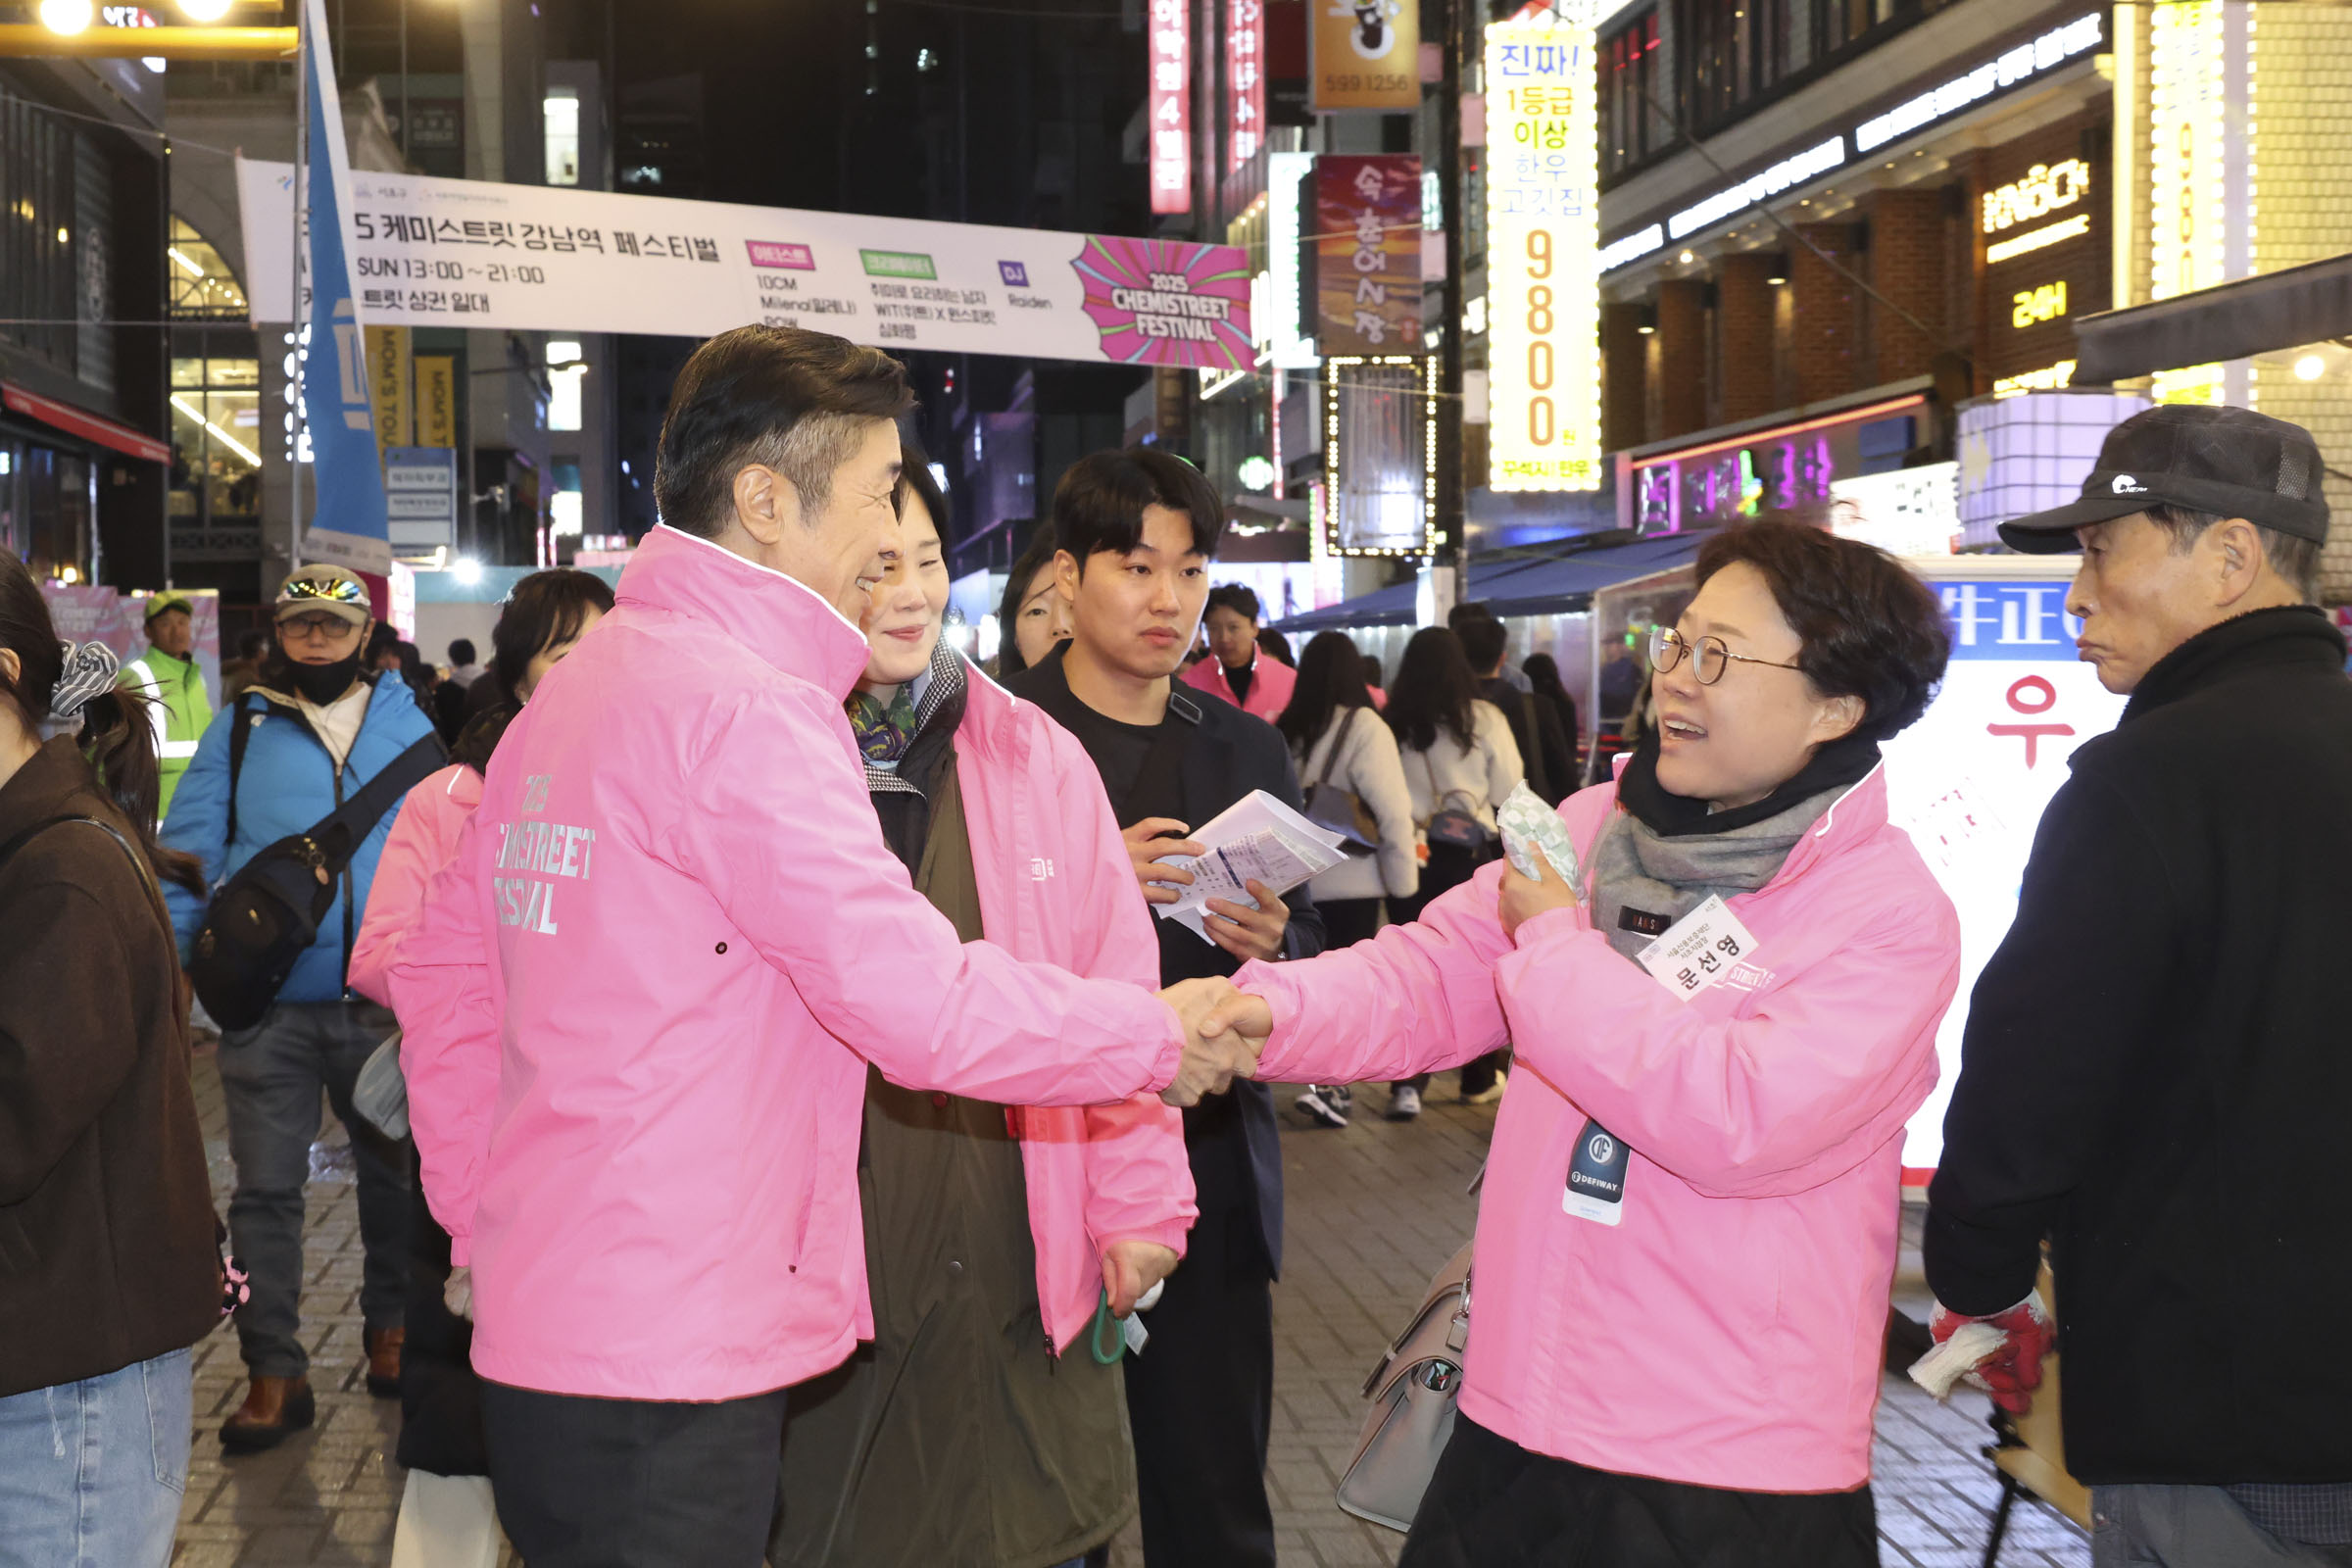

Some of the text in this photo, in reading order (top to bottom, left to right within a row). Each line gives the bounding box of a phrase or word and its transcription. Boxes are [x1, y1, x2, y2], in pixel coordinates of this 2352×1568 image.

[1499, 45, 1580, 76] 진짜!
[1506, 86, 1574, 116] 1등급
[1514, 120, 1569, 149] 이상
[1515, 153, 1568, 182] 한우
[1499, 187, 1583, 217] 고깃집
[353, 211, 721, 264] 5 케미스트릿 강남역 페스티벌
[357, 257, 400, 278] SUN
[403, 258, 465, 281] 13:00
[486, 263, 546, 284] 21:00
[757, 273, 799, 291] 10CM
[1003, 266, 1025, 281] DJ
[1149, 272, 1190, 292] 2025
[360, 288, 491, 315] 트릿 상권 일대
[1006, 292, 1054, 310] Raiden
[1111, 287, 1231, 320] CHEMISTREET
[2012, 280, 2068, 328] 24H
[1135, 313, 1219, 342] FESTIVAL
[1526, 228, 1555, 447] 9800
[381, 329, 397, 397] MOM'S
[1942, 583, 2083, 647] 牛正
[1984, 673, 2077, 772] 우
[1675, 933, 1740, 991] 문선영
[1581, 1174, 1619, 1192] DEFIWAY
